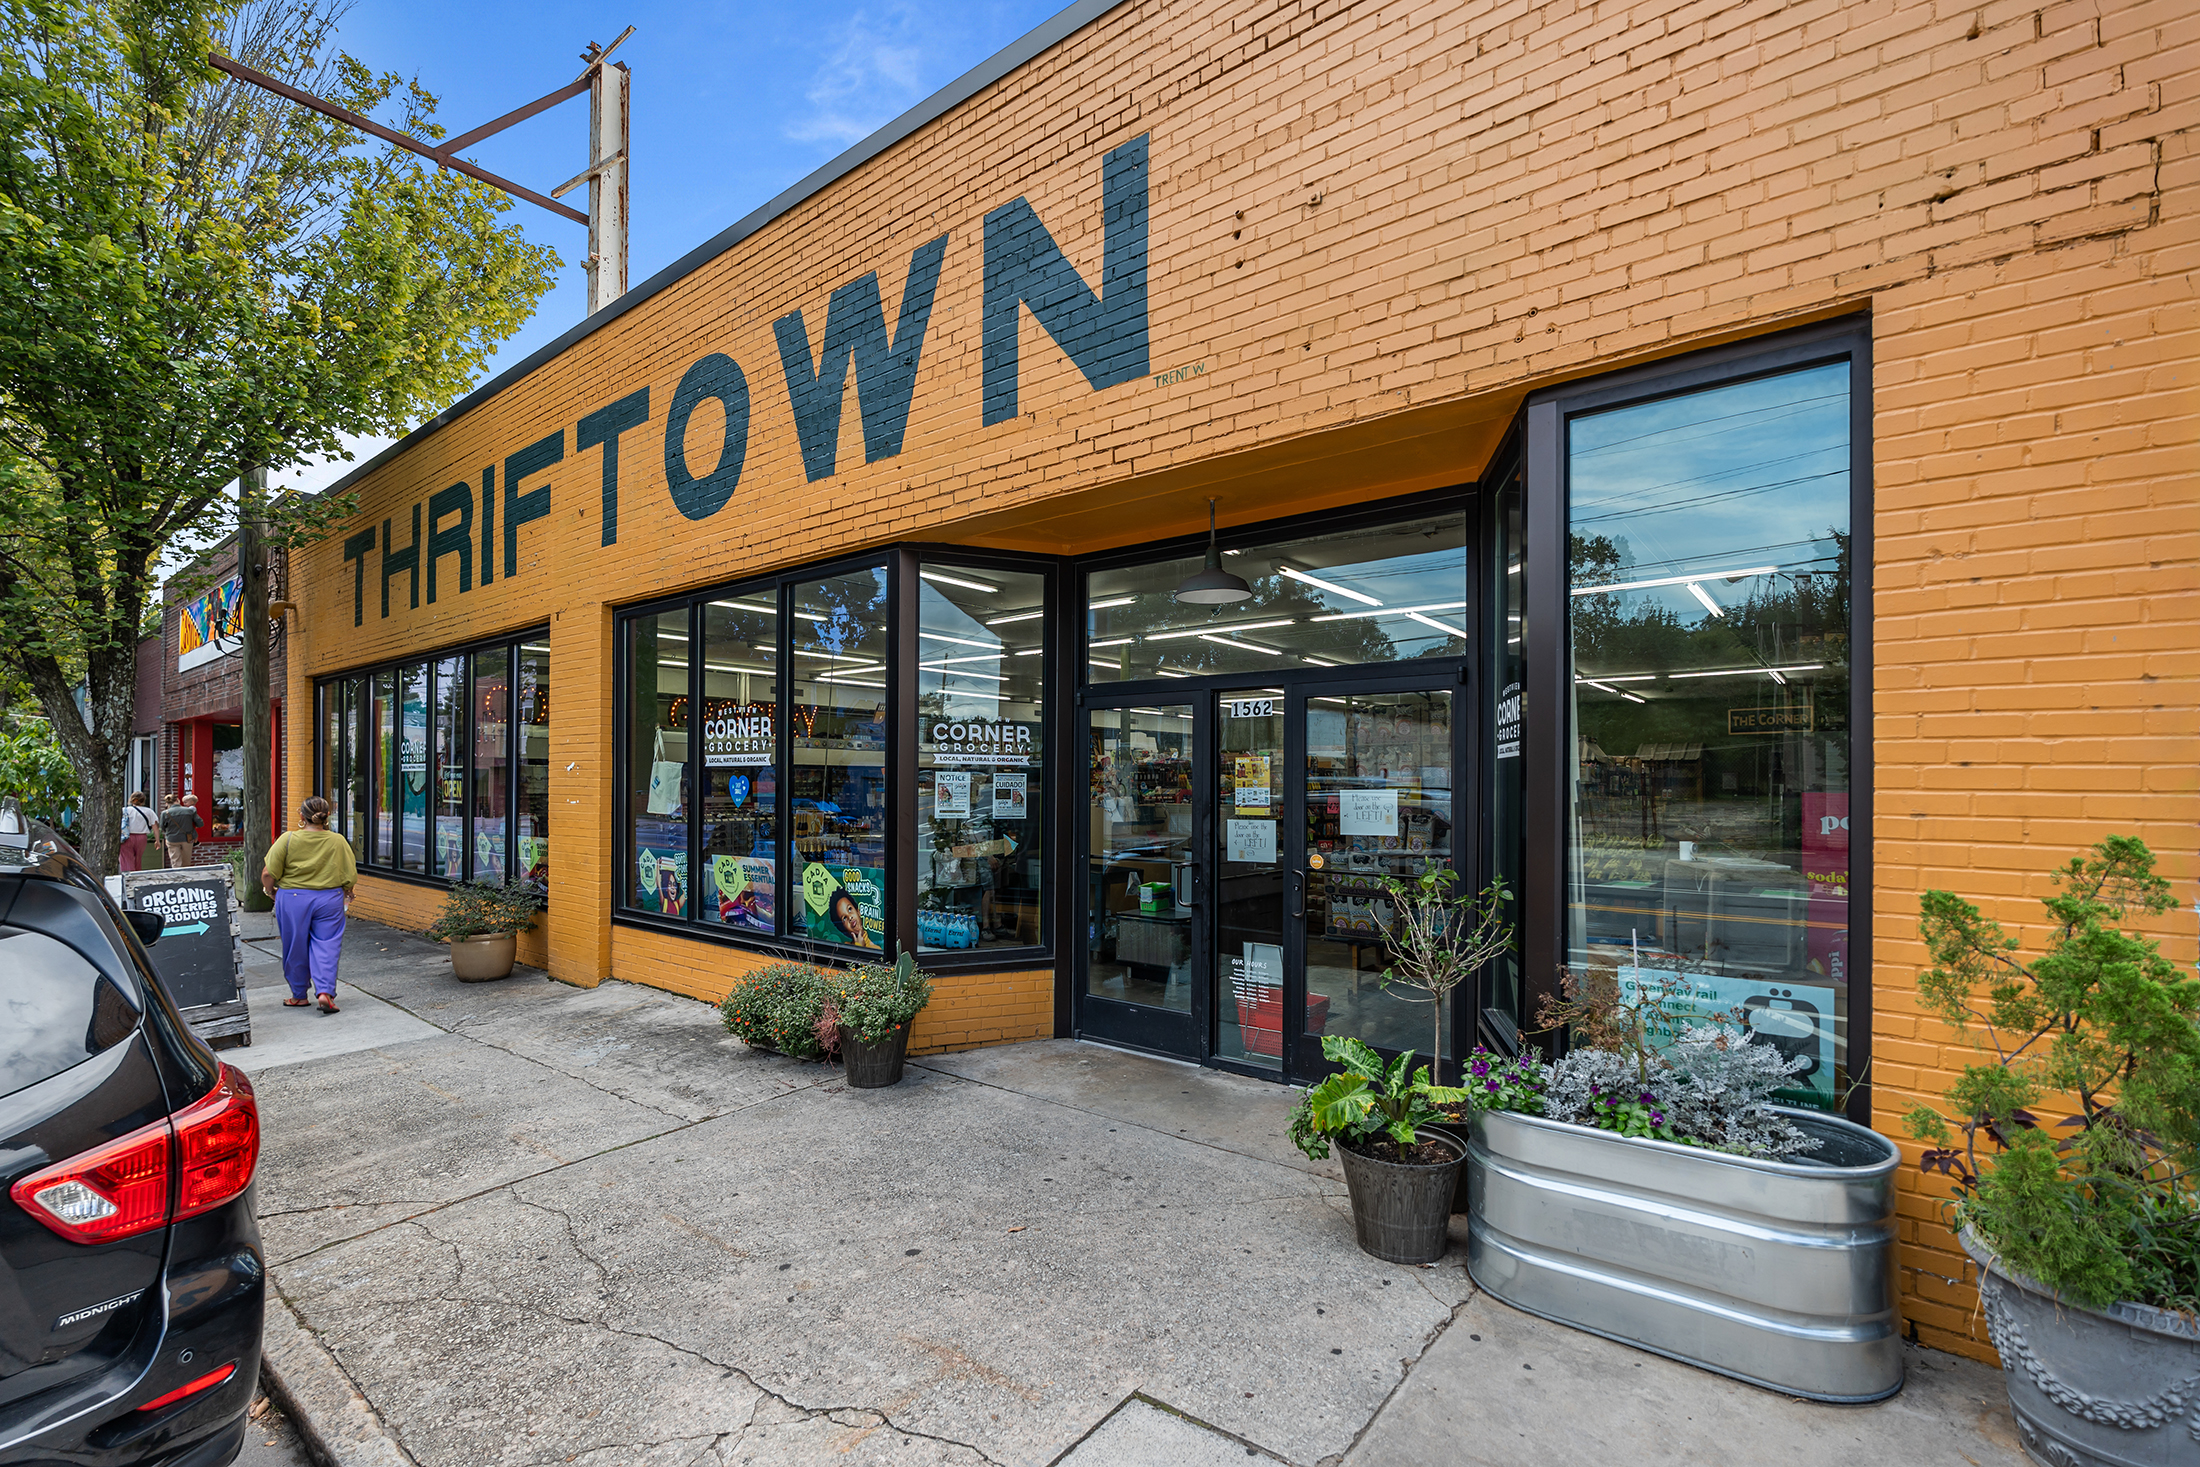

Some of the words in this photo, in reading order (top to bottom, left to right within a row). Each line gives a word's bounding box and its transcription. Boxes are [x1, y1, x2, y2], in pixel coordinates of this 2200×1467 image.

[1153, 366, 1191, 388] TRENT
[1234, 701, 1271, 717] 1562
[705, 716, 772, 740] CORNER
[1733, 714, 1756, 727] THE
[932, 722, 1031, 743] CORNER
[709, 740, 768, 752] GROCERY
[939, 742, 1025, 754] GROCERY
[940, 774, 966, 782] NOTICE
[444, 780, 462, 797] OPEN
[719, 859, 738, 874] CADIA
[742, 864, 769, 875] SUMMER
[806, 868, 829, 885] CADIA
[846, 882, 871, 893] SNACKS
[142, 887, 215, 907] ORGANIC
[164, 909, 218, 923] RODUCE
[860, 904, 879, 919] BRAIN
[1231, 958, 1244, 966] OUR
[1246, 960, 1267, 969] HOURS
[1695, 990, 1718, 1000] rail
[59, 1293, 141, 1327] MIDNIGHT
